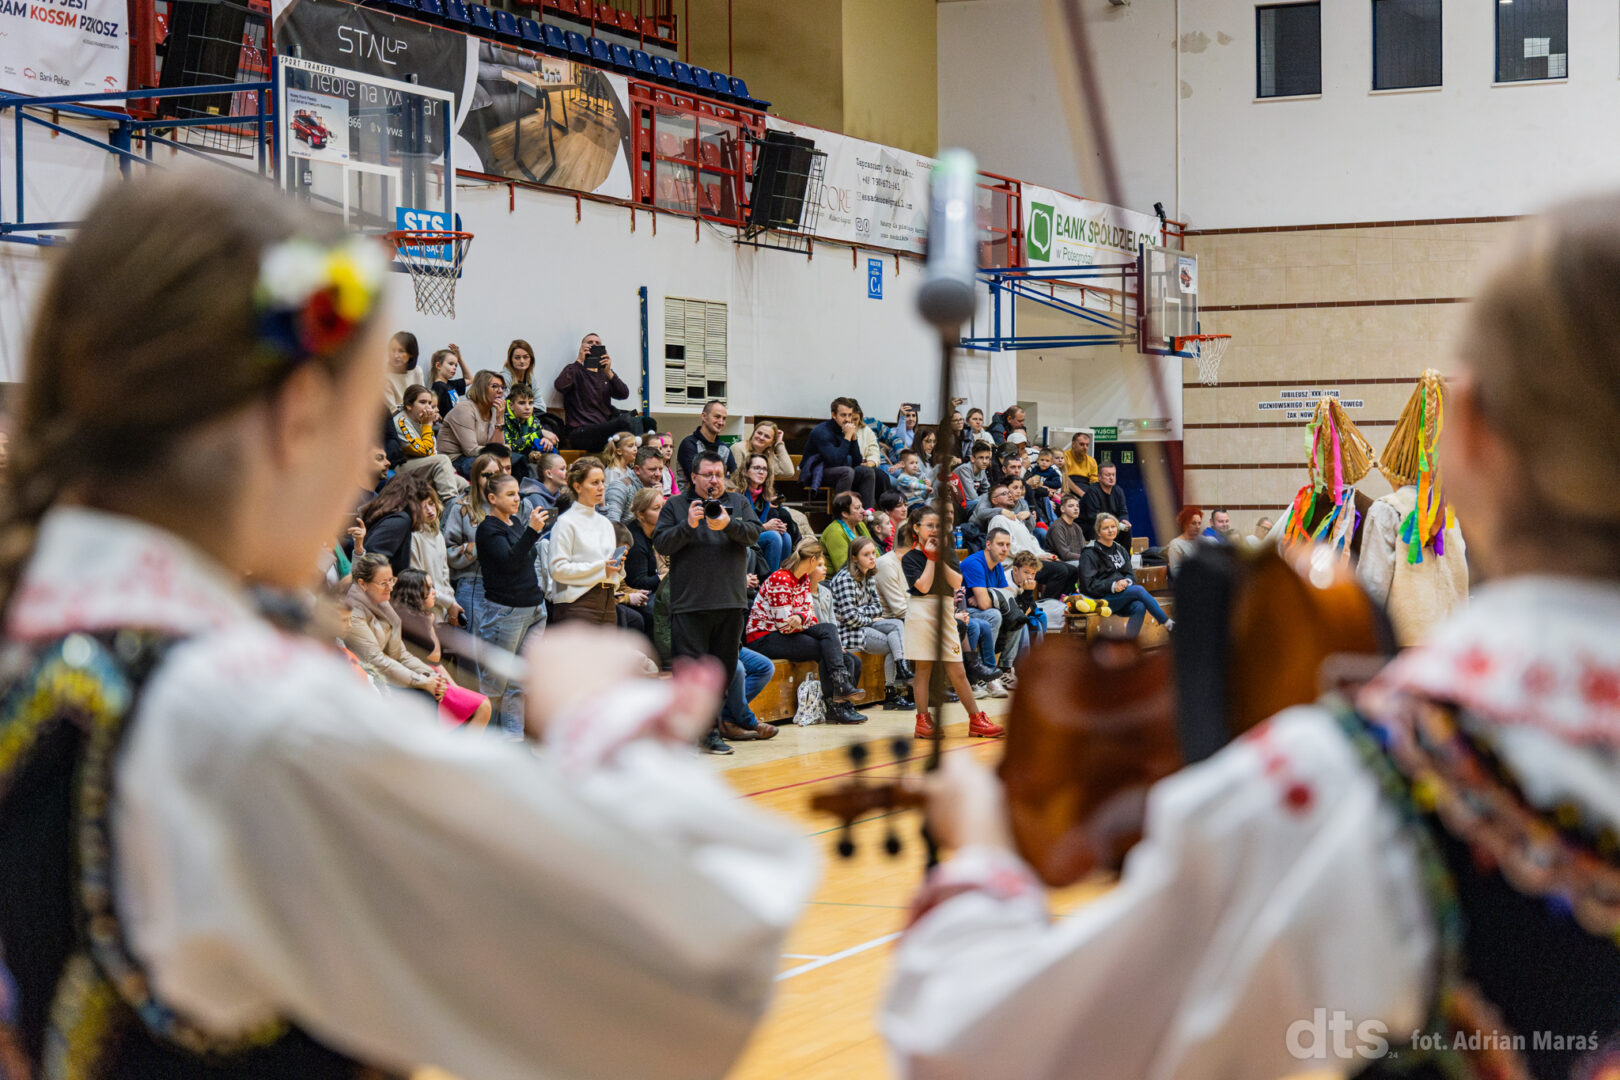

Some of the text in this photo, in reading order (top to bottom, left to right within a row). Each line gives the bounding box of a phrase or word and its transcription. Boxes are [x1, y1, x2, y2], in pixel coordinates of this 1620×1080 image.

[30, 4, 77, 28] KOSSM
[79, 15, 118, 37] PZKOSZ
[280, 56, 336, 75] SPORT TRANSFER
[39, 71, 53, 83] Bank
[359, 82, 377, 103] na
[403, 211, 444, 237] STS
[1056, 213, 1086, 241] BANK
[1281, 391, 1308, 399] JUBILEUSZ
[1258, 401, 1303, 410] UCZNIOWSKIEGO
[1300, 411, 1314, 419] NOW
